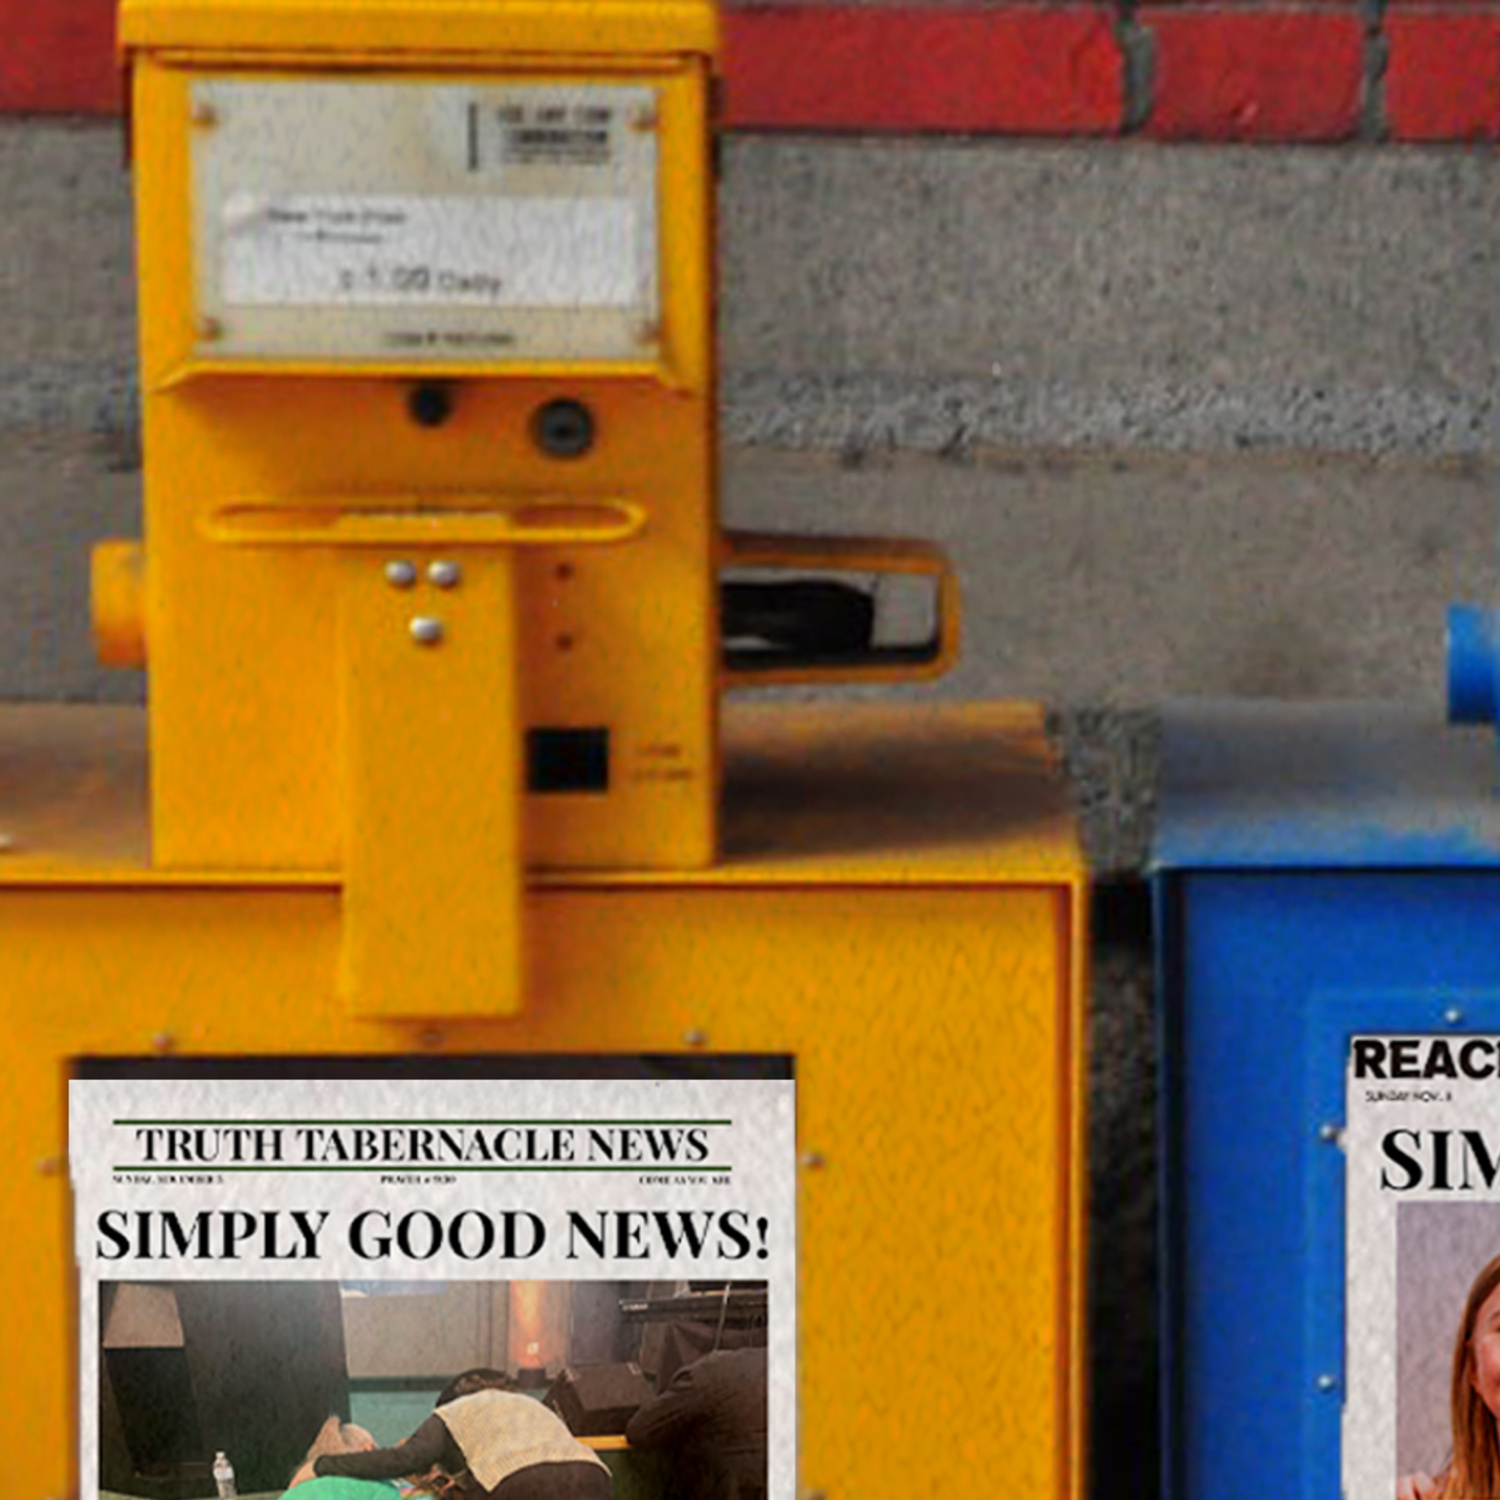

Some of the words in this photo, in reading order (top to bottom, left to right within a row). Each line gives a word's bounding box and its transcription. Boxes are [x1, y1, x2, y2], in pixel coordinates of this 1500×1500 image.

[137, 1127, 283, 1163] TRUTH
[297, 1127, 575, 1163] TABERNACLE
[588, 1127, 710, 1163] NEWS
[96, 1208, 330, 1261] SIMPLY
[347, 1208, 546, 1261] GOOD
[565, 1208, 770, 1261] NEWS!
